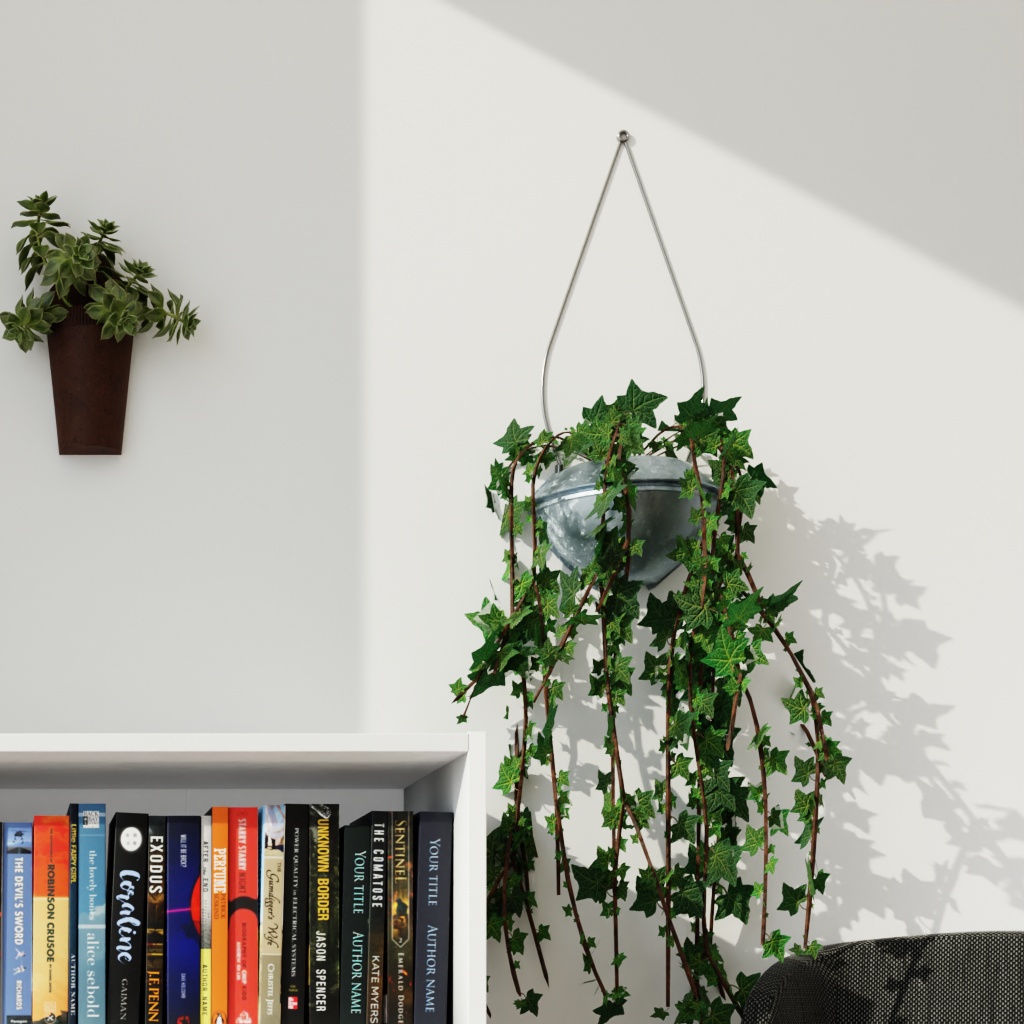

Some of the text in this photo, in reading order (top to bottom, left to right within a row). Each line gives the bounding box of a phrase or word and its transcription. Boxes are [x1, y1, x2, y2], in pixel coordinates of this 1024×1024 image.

[238, 819, 246, 844] STARRY
[238, 846, 246, 870] STARRY
[372, 823, 385, 907] THE COMATOSE
[395, 820, 407, 883] SENTINEL
[14, 857, 24, 945] THE DEVIL'S SWORD
[87, 867, 96, 892] lovely
[214, 848, 226, 893] PERFUME
[317, 819, 329, 921] UNKNOWN BORDER
[428, 839, 440, 906] YOUR TITLE
[47, 864, 55, 962] ROBINSON CRUSOE
[115, 870, 140, 964] Coraline
[267, 923, 279, 945] Wife
[87, 933, 99, 1018] alice sebold
[120, 978, 128, 1020] GAIMAN
[315, 931, 326, 1011] JASON SPENCER
[370, 955, 380, 1024] KATE MYERS
[425, 925, 438, 1012] AUTHOR NAME
